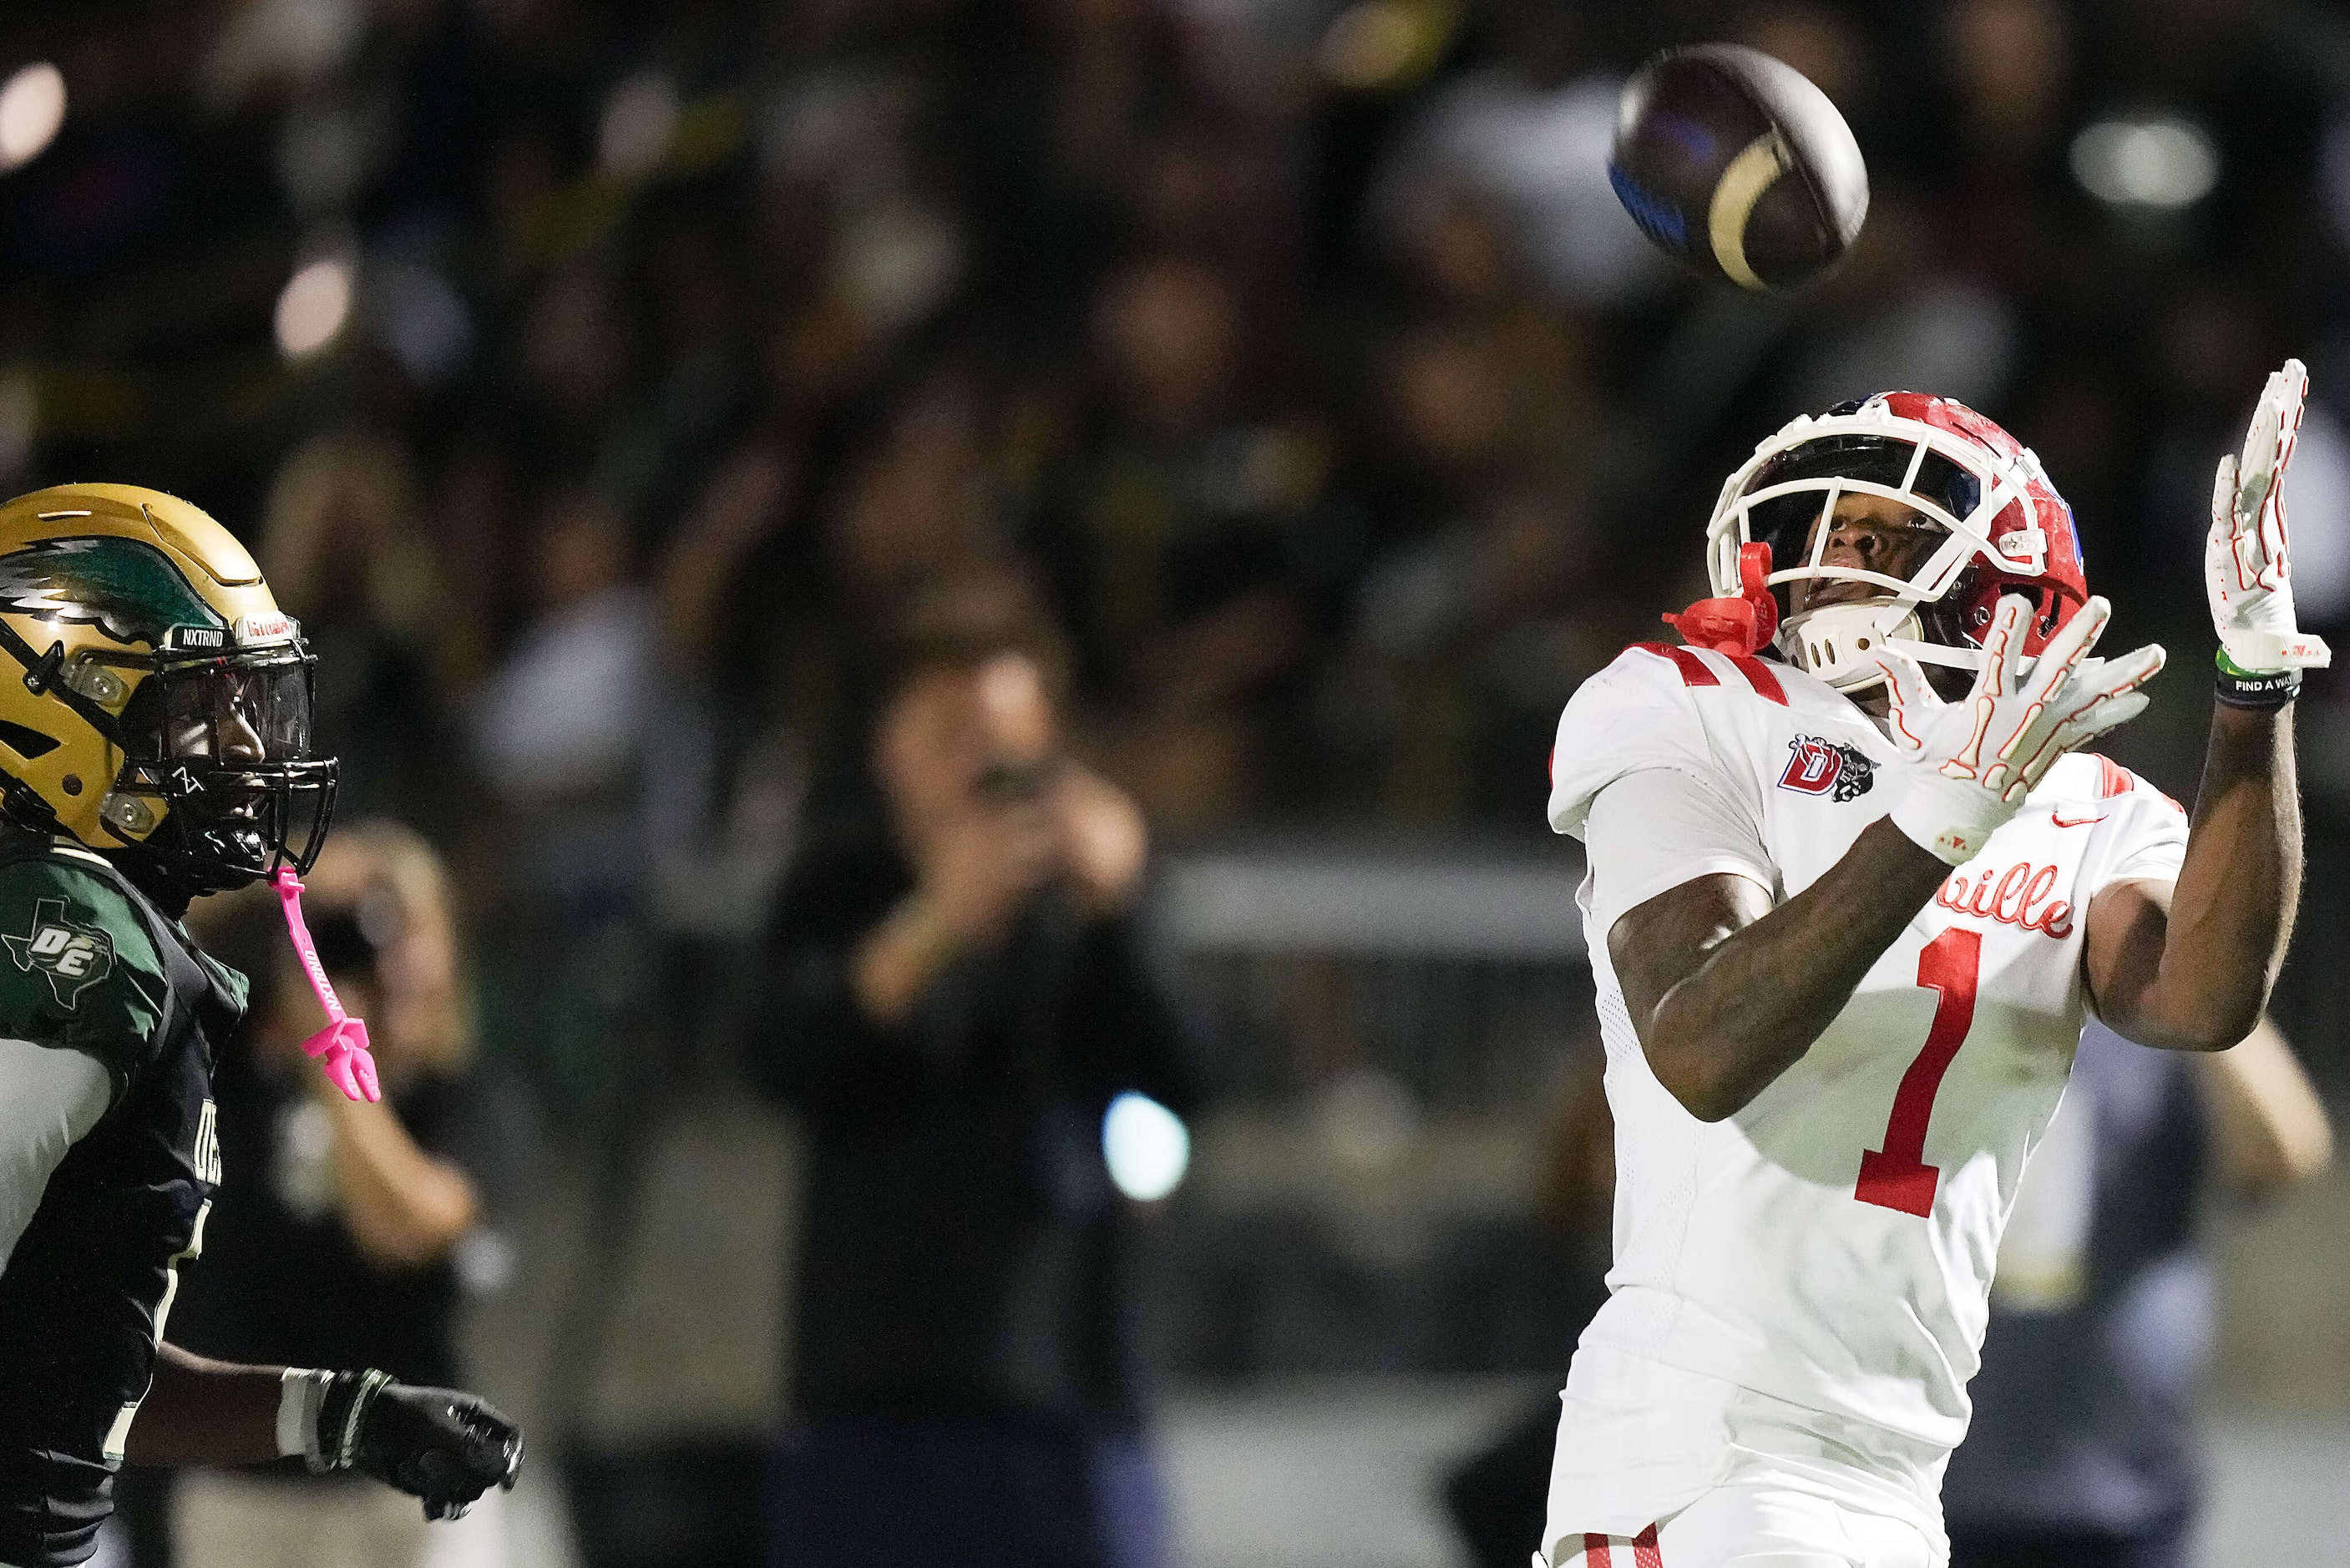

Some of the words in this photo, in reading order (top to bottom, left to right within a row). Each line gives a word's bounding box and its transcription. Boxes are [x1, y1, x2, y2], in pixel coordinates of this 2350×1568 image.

[183, 629, 223, 647] NXTRND
[2236, 680, 2262, 691] FIND
[2265, 680, 2274, 690] A
[304, 950, 342, 1010] NXTRND
[1854, 925, 1983, 1219] 1
